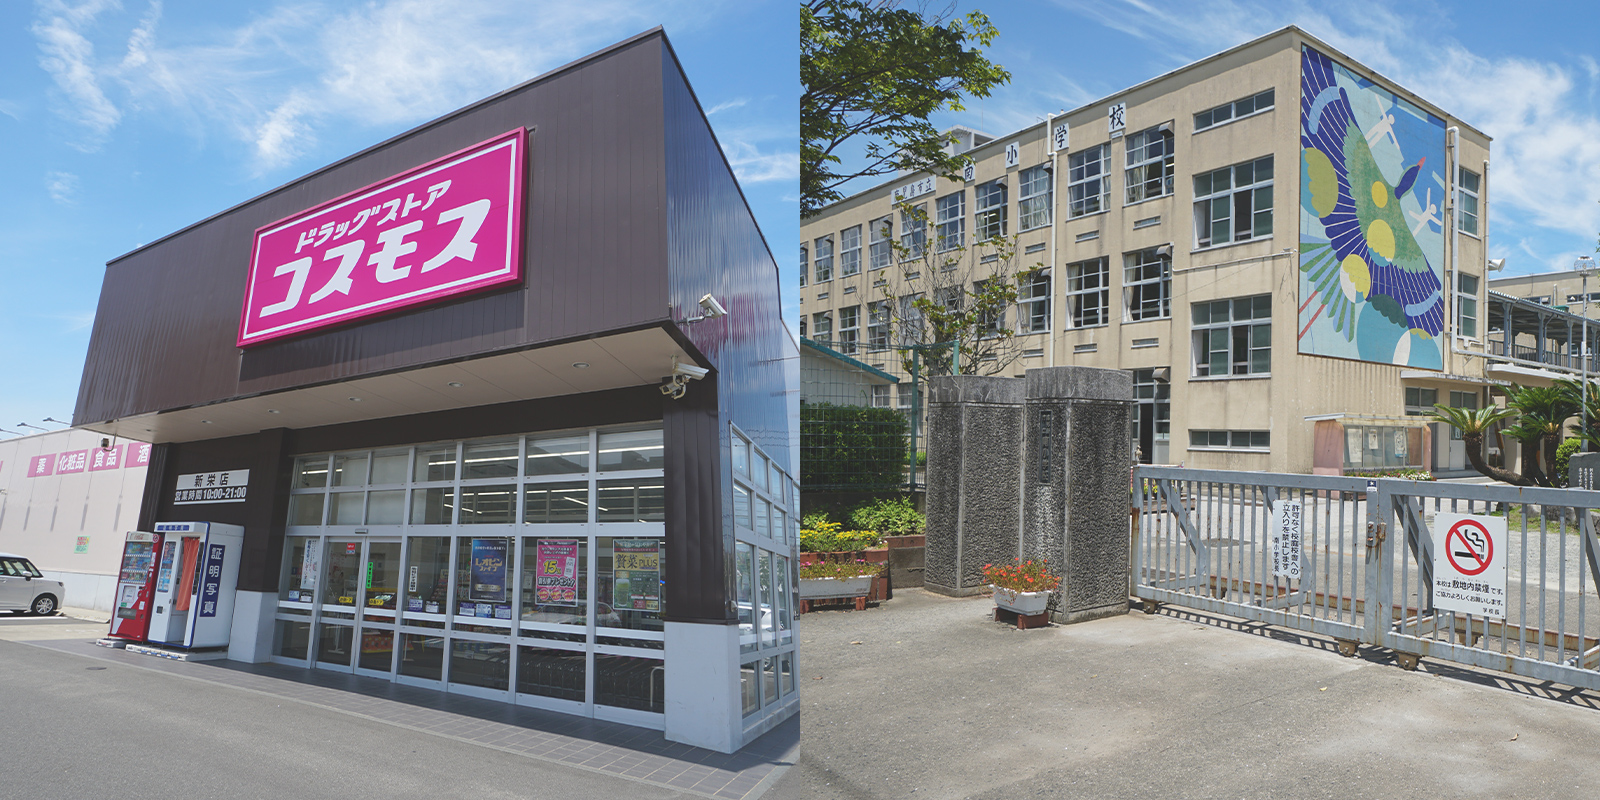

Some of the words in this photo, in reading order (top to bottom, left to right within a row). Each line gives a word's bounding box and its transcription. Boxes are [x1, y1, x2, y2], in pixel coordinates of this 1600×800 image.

[294, 179, 452, 254] ドラッグストア
[258, 198, 491, 318] コスモス
[36, 458, 47, 474] 薬
[58, 452, 86, 472] 化粧品
[93, 448, 118, 468] 食品
[137, 444, 151, 463] 酒
[194, 472, 229, 488] 新栄店
[1281, 503, 1291, 571] 立入りを禁止します
[1290, 504, 1300, 576] 許可なく校庭校舎への
[203, 547, 223, 614] 証明写真
[1435, 591, 1504, 607] ご協力よろしくお願いします。
